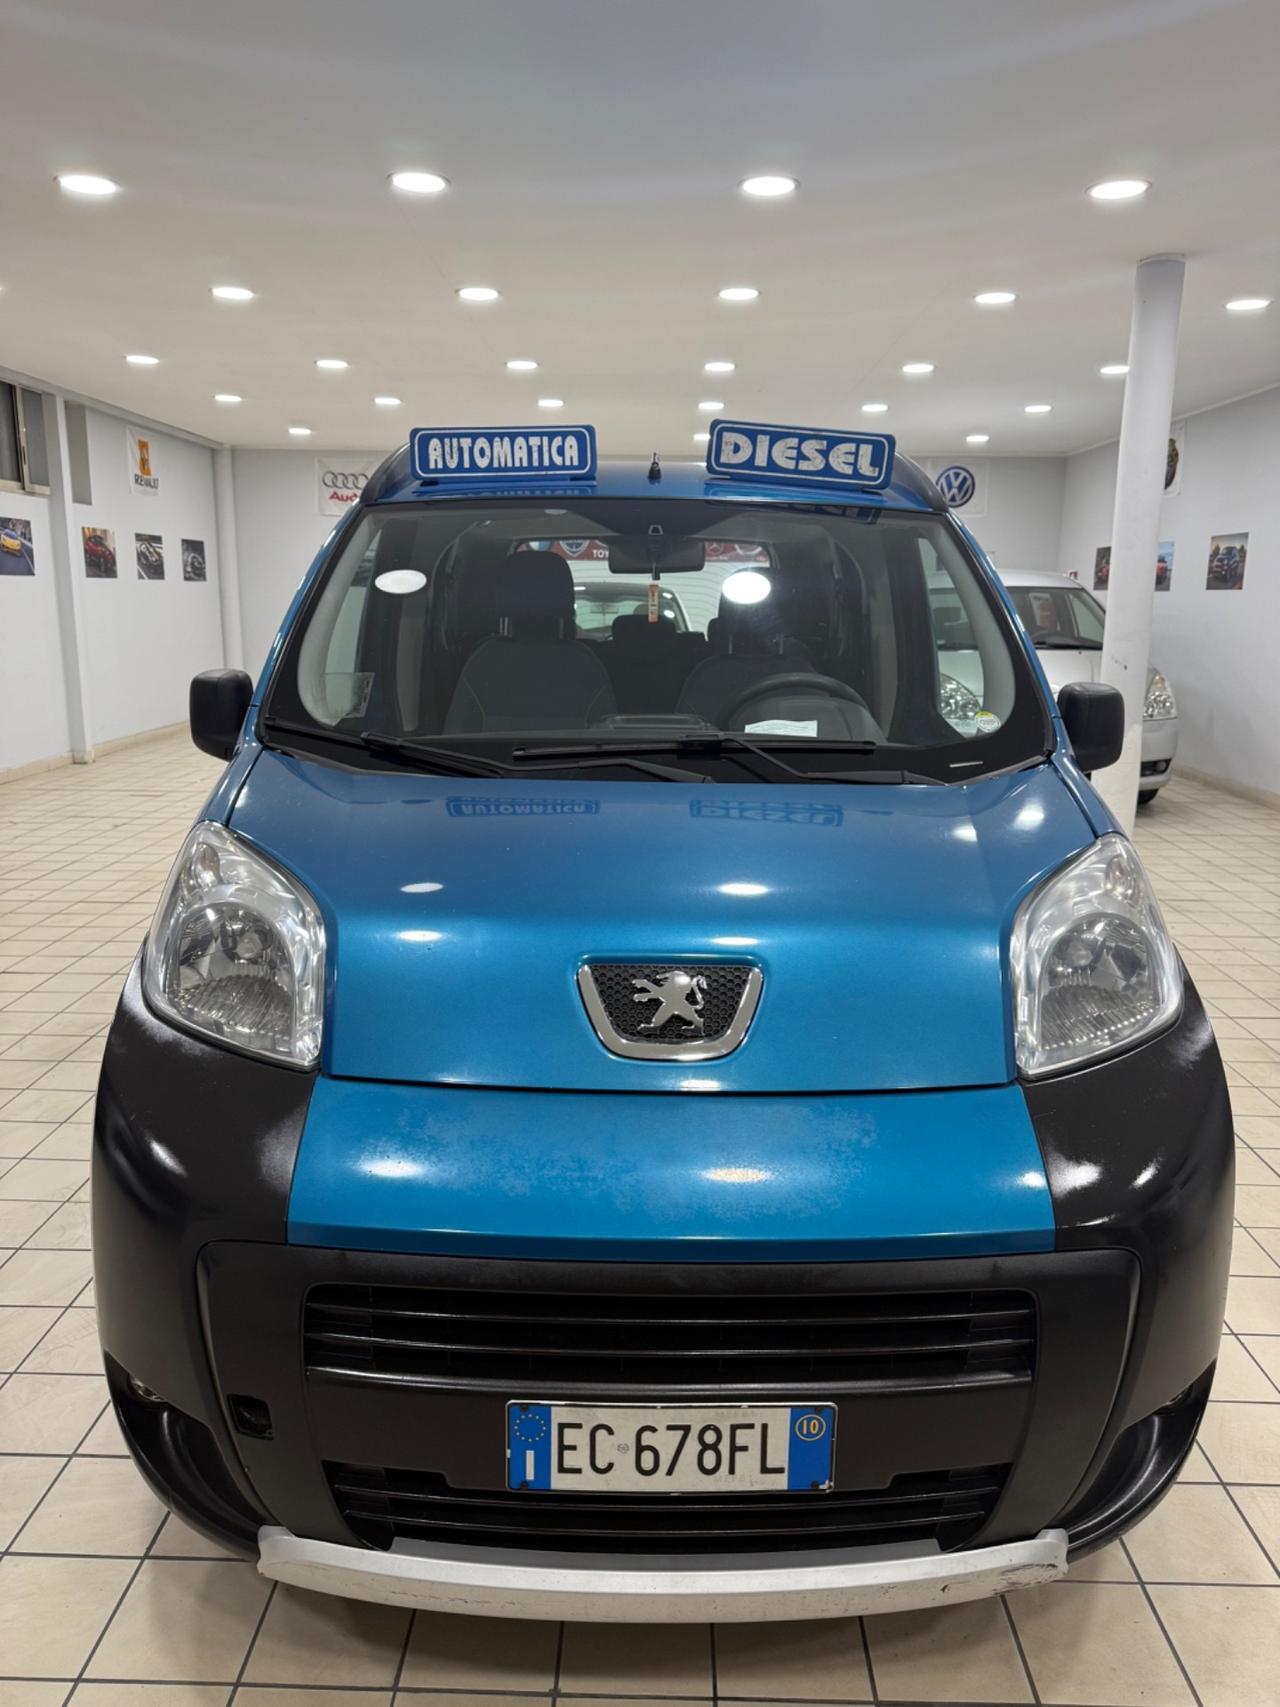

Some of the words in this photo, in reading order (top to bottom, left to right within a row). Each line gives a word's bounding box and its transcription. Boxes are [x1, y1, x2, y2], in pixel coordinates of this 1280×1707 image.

[428, 435, 579, 470] AUTOMATICA
[720, 431, 879, 477] DIESEL
[329, 491, 359, 503] Aud
[801, 1419, 820, 1435] 10
[556, 1422, 615, 1475] EC
[634, 1422, 786, 1478] 678FL
